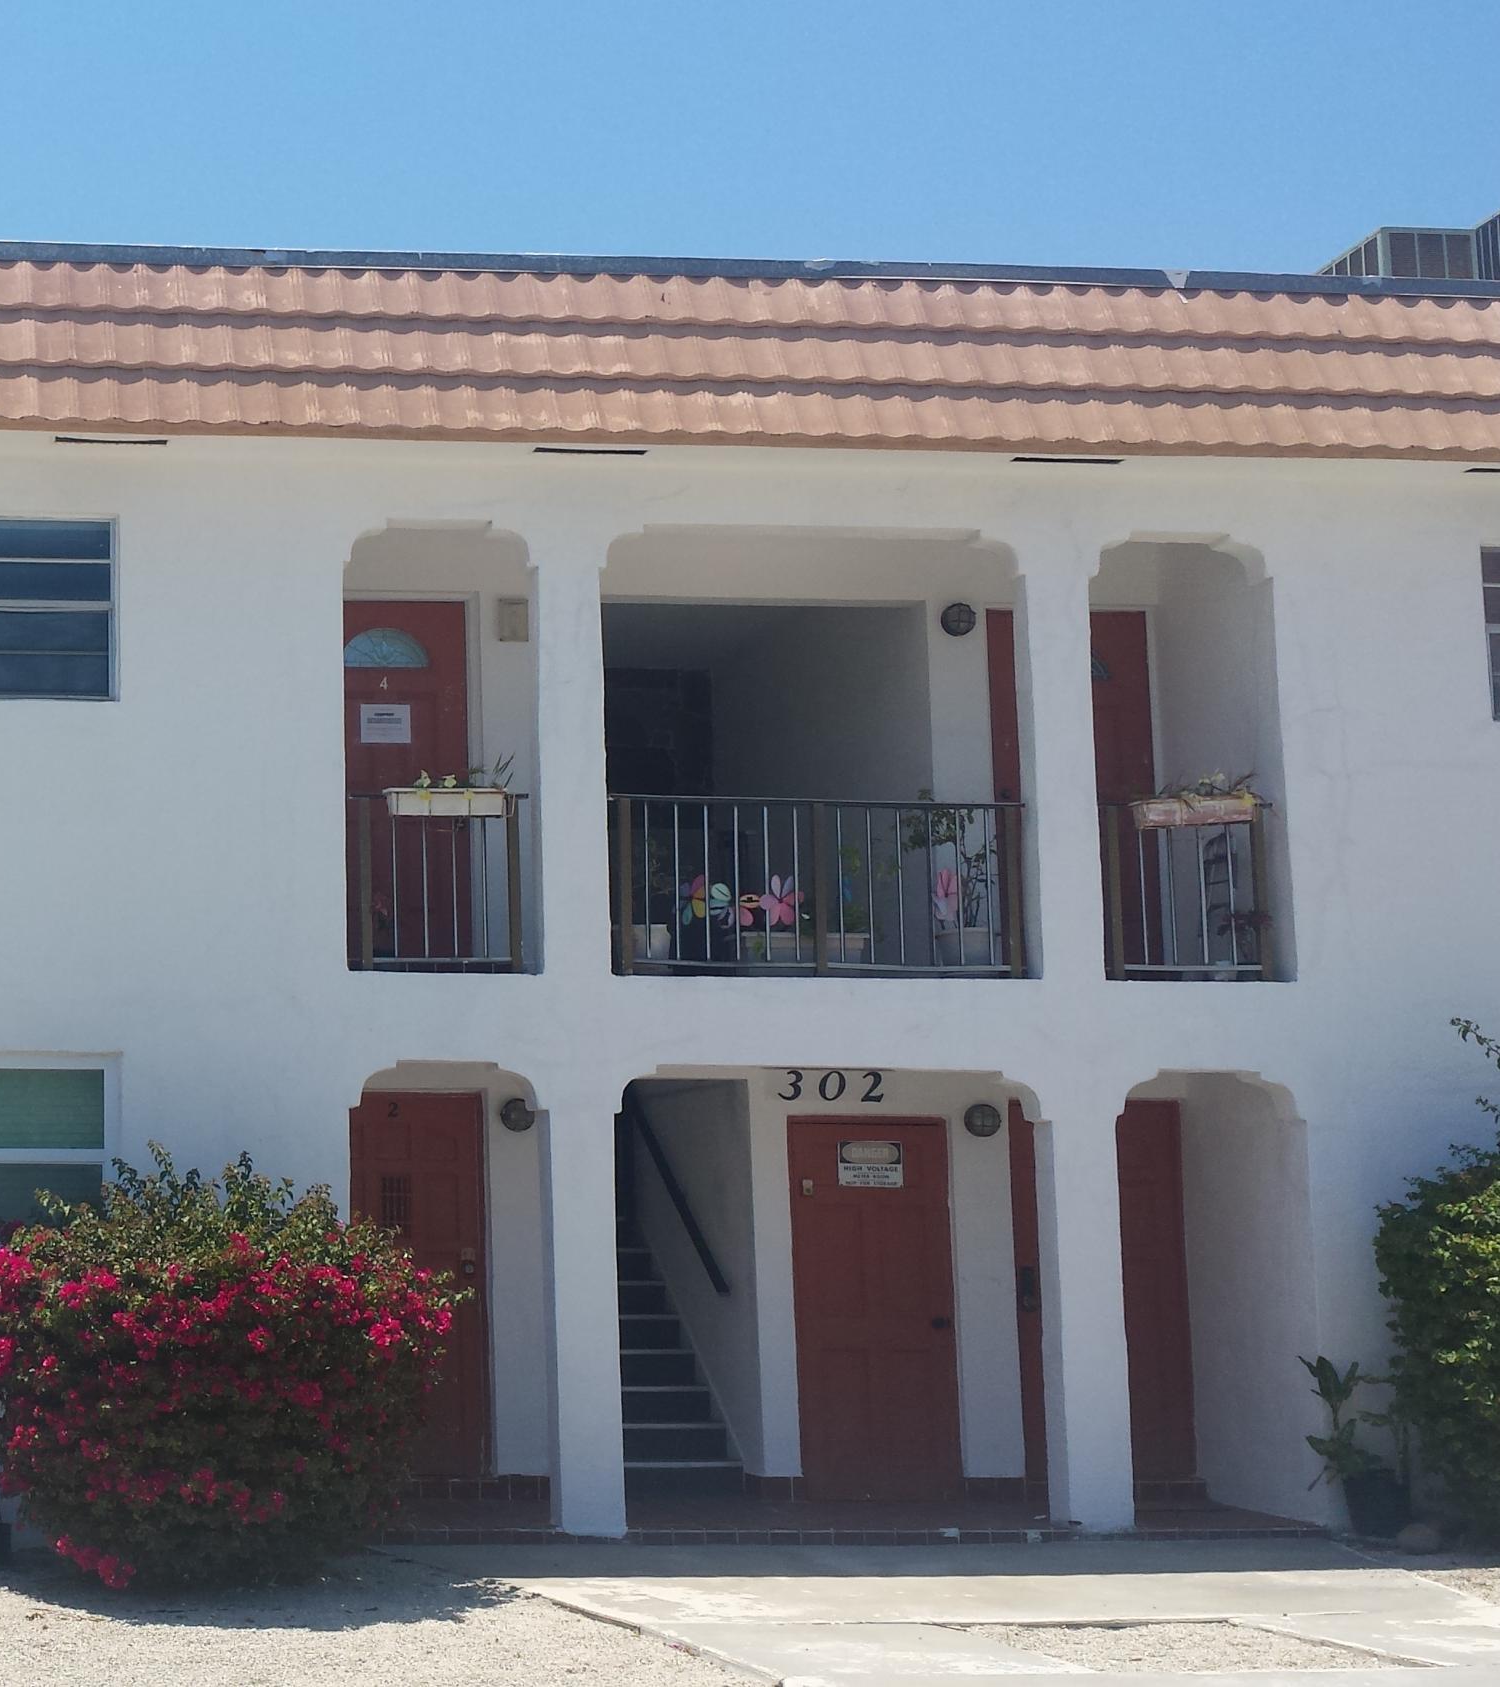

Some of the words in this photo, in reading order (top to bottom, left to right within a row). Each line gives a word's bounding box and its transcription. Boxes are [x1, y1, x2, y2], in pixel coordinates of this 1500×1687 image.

[380, 676, 388, 691] 4
[777, 1070, 884, 1103] 302
[388, 1102, 398, 1118] 2
[867, 1165, 899, 1173] VOLTAGE
